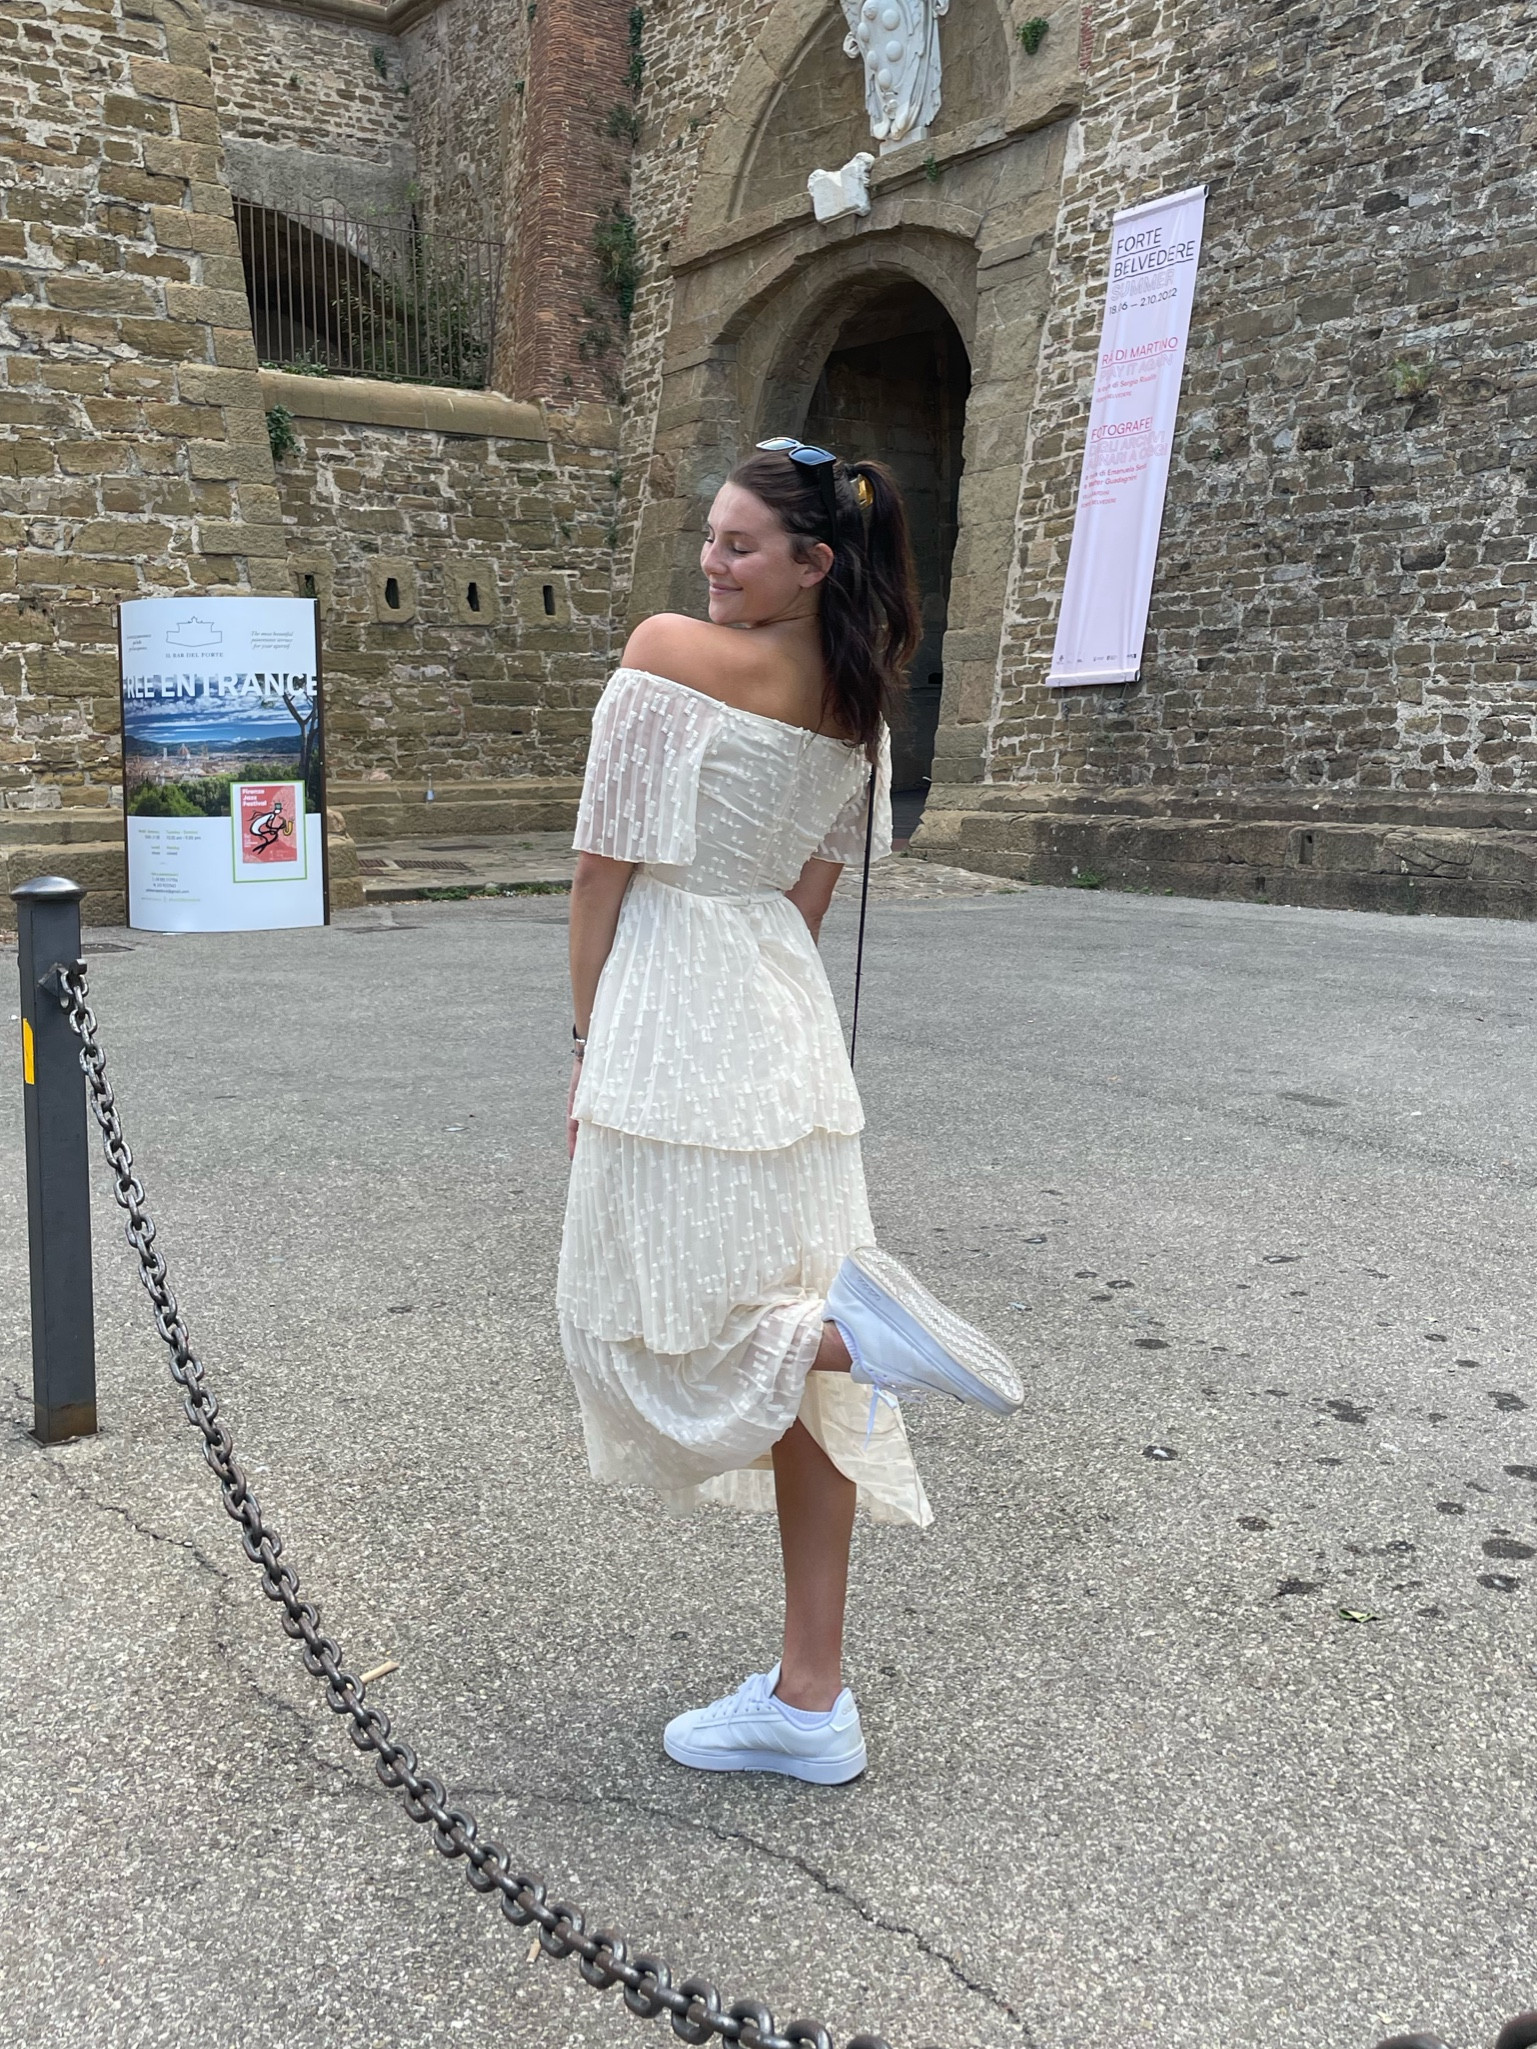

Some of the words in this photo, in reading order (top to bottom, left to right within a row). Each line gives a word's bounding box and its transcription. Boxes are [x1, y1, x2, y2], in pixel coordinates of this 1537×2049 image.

[1116, 227, 1162, 255] FORTE
[1114, 240, 1195, 278] BELVEDERE
[1111, 268, 1175, 301] SUMMER
[1115, 349, 1128, 361] DI
[1130, 337, 1178, 359] MARTINO
[1126, 362, 1138, 376] IT
[1107, 466, 1135, 475] Emanuela
[161, 672, 318, 697] ENTRANCE
[242, 799, 268, 807] Festival
